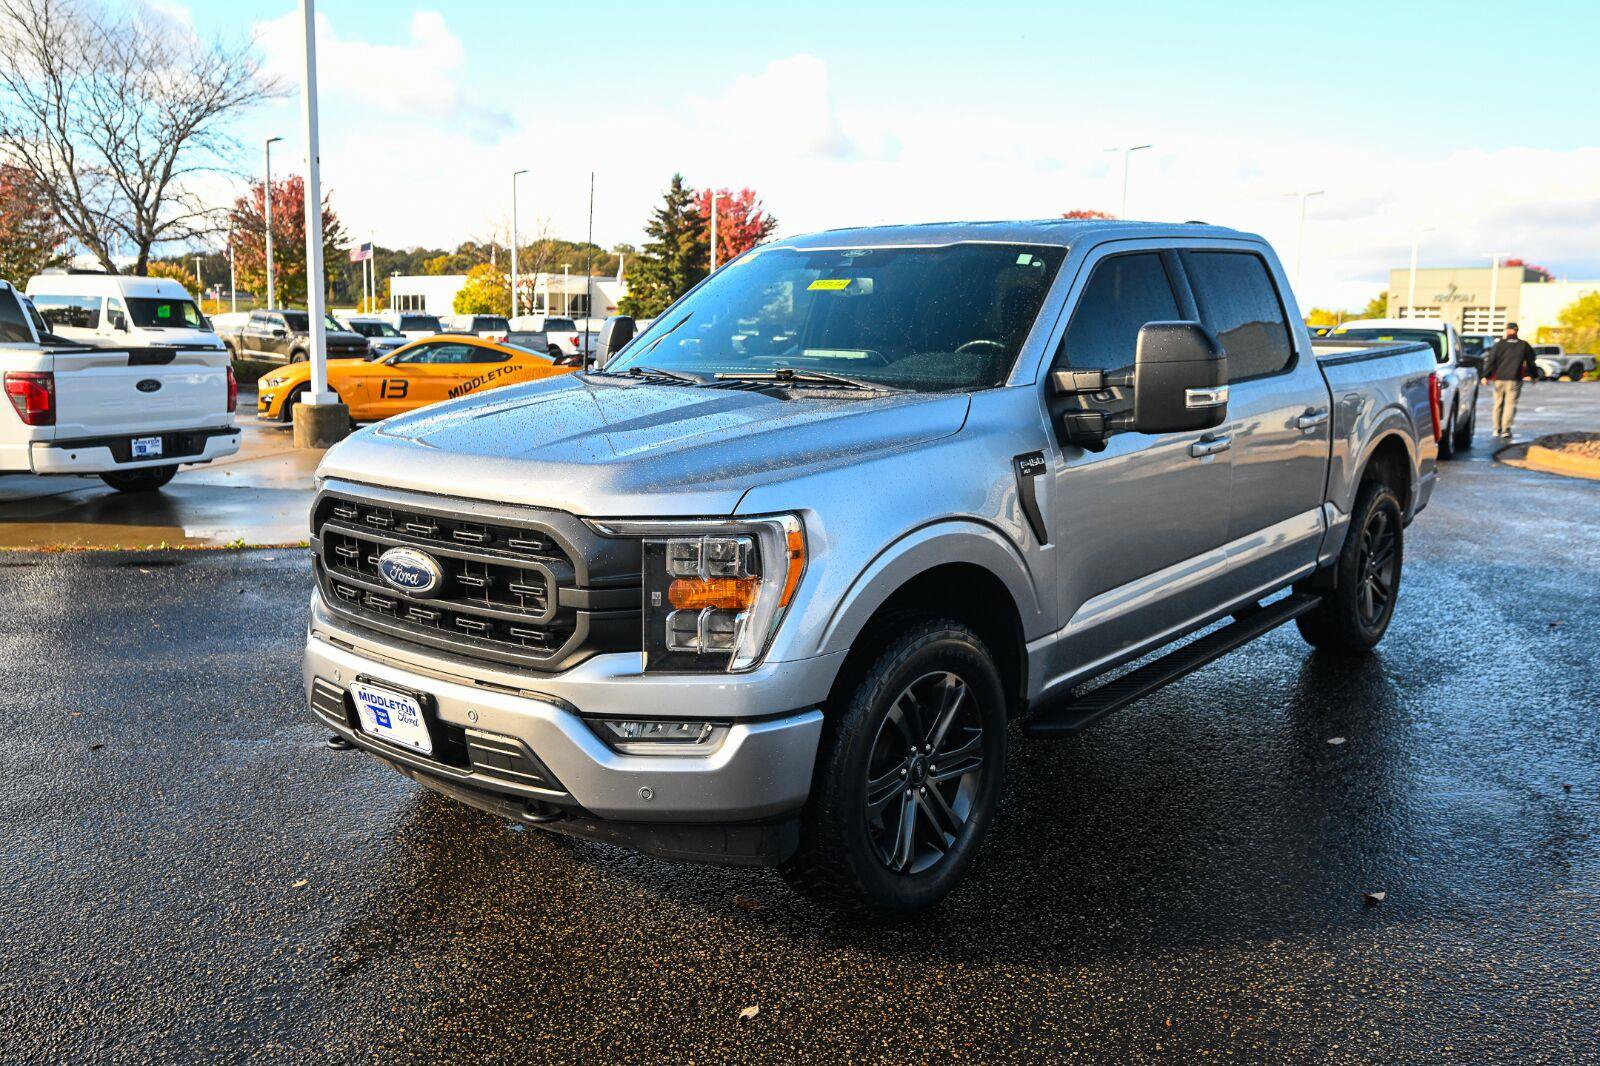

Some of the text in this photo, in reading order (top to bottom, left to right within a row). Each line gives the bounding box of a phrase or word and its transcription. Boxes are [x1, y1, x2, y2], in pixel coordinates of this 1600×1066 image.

[380, 379, 408, 399] 13
[447, 364, 524, 400] MIDDLETON
[389, 561, 420, 586] Ford
[358, 691, 416, 717] MIDDLETON
[397, 709, 420, 728] Ford
